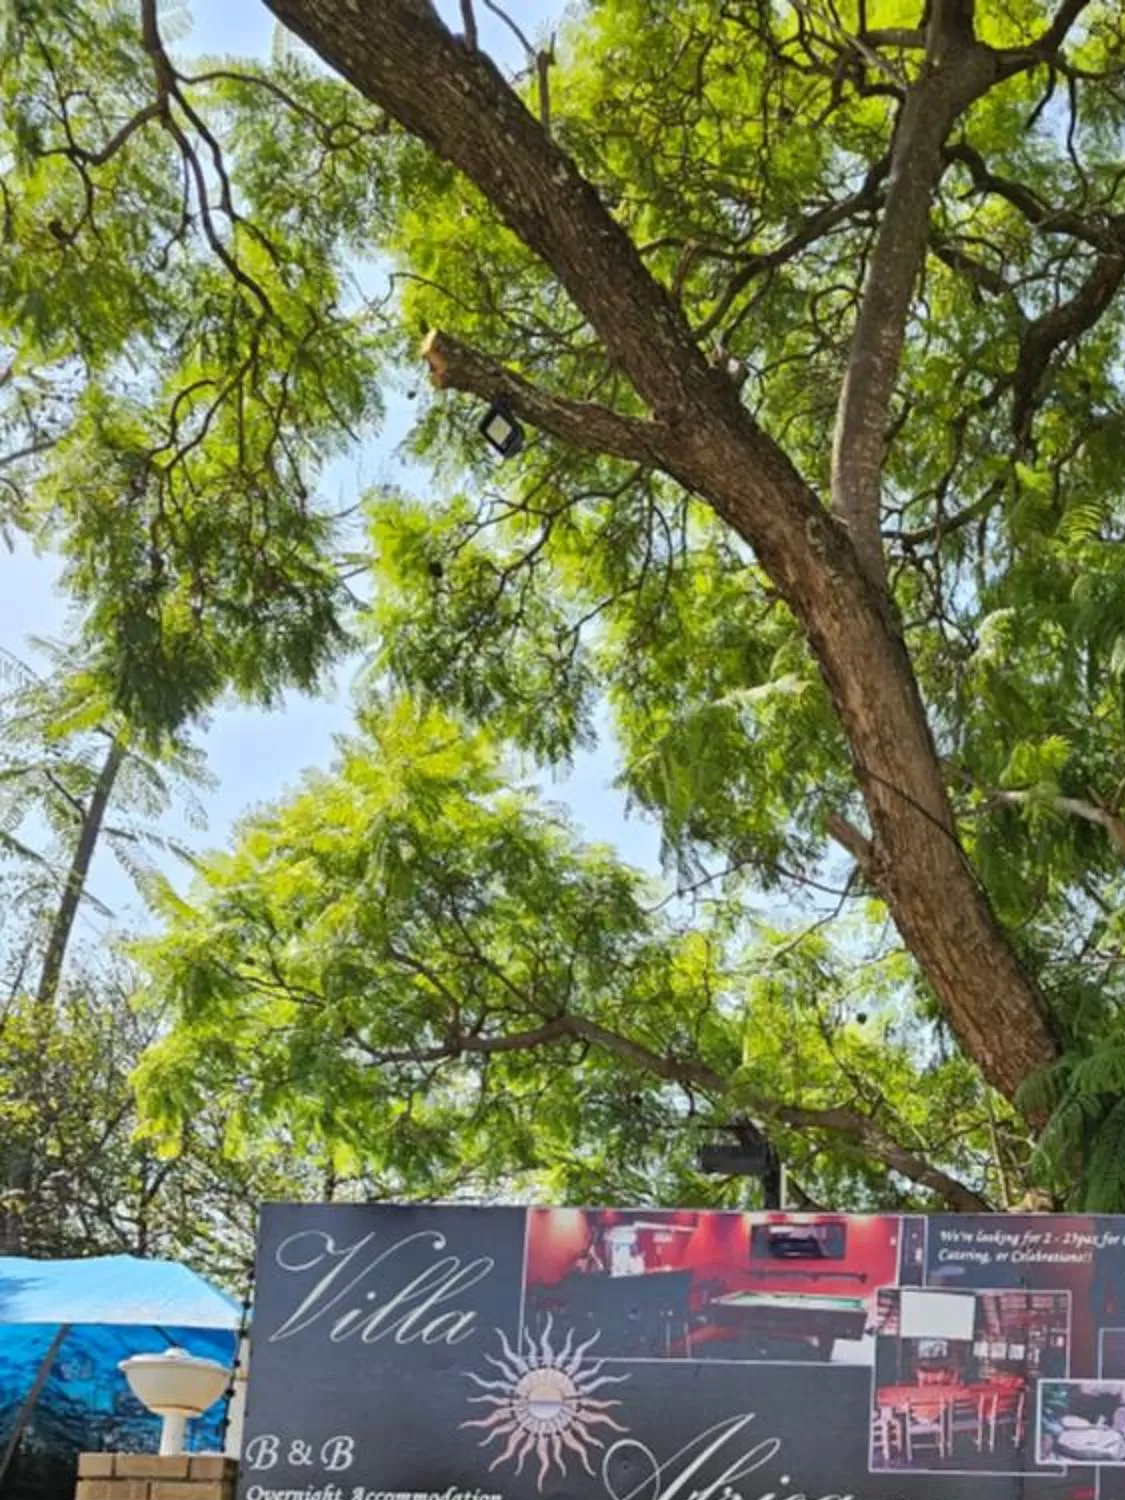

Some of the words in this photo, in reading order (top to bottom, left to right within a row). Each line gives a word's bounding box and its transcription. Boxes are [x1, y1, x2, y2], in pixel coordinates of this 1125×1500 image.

[268, 1230, 495, 1345] Villa
[245, 1434, 280, 1470] B
[287, 1439, 313, 1466] &
[320, 1435, 355, 1471] B
